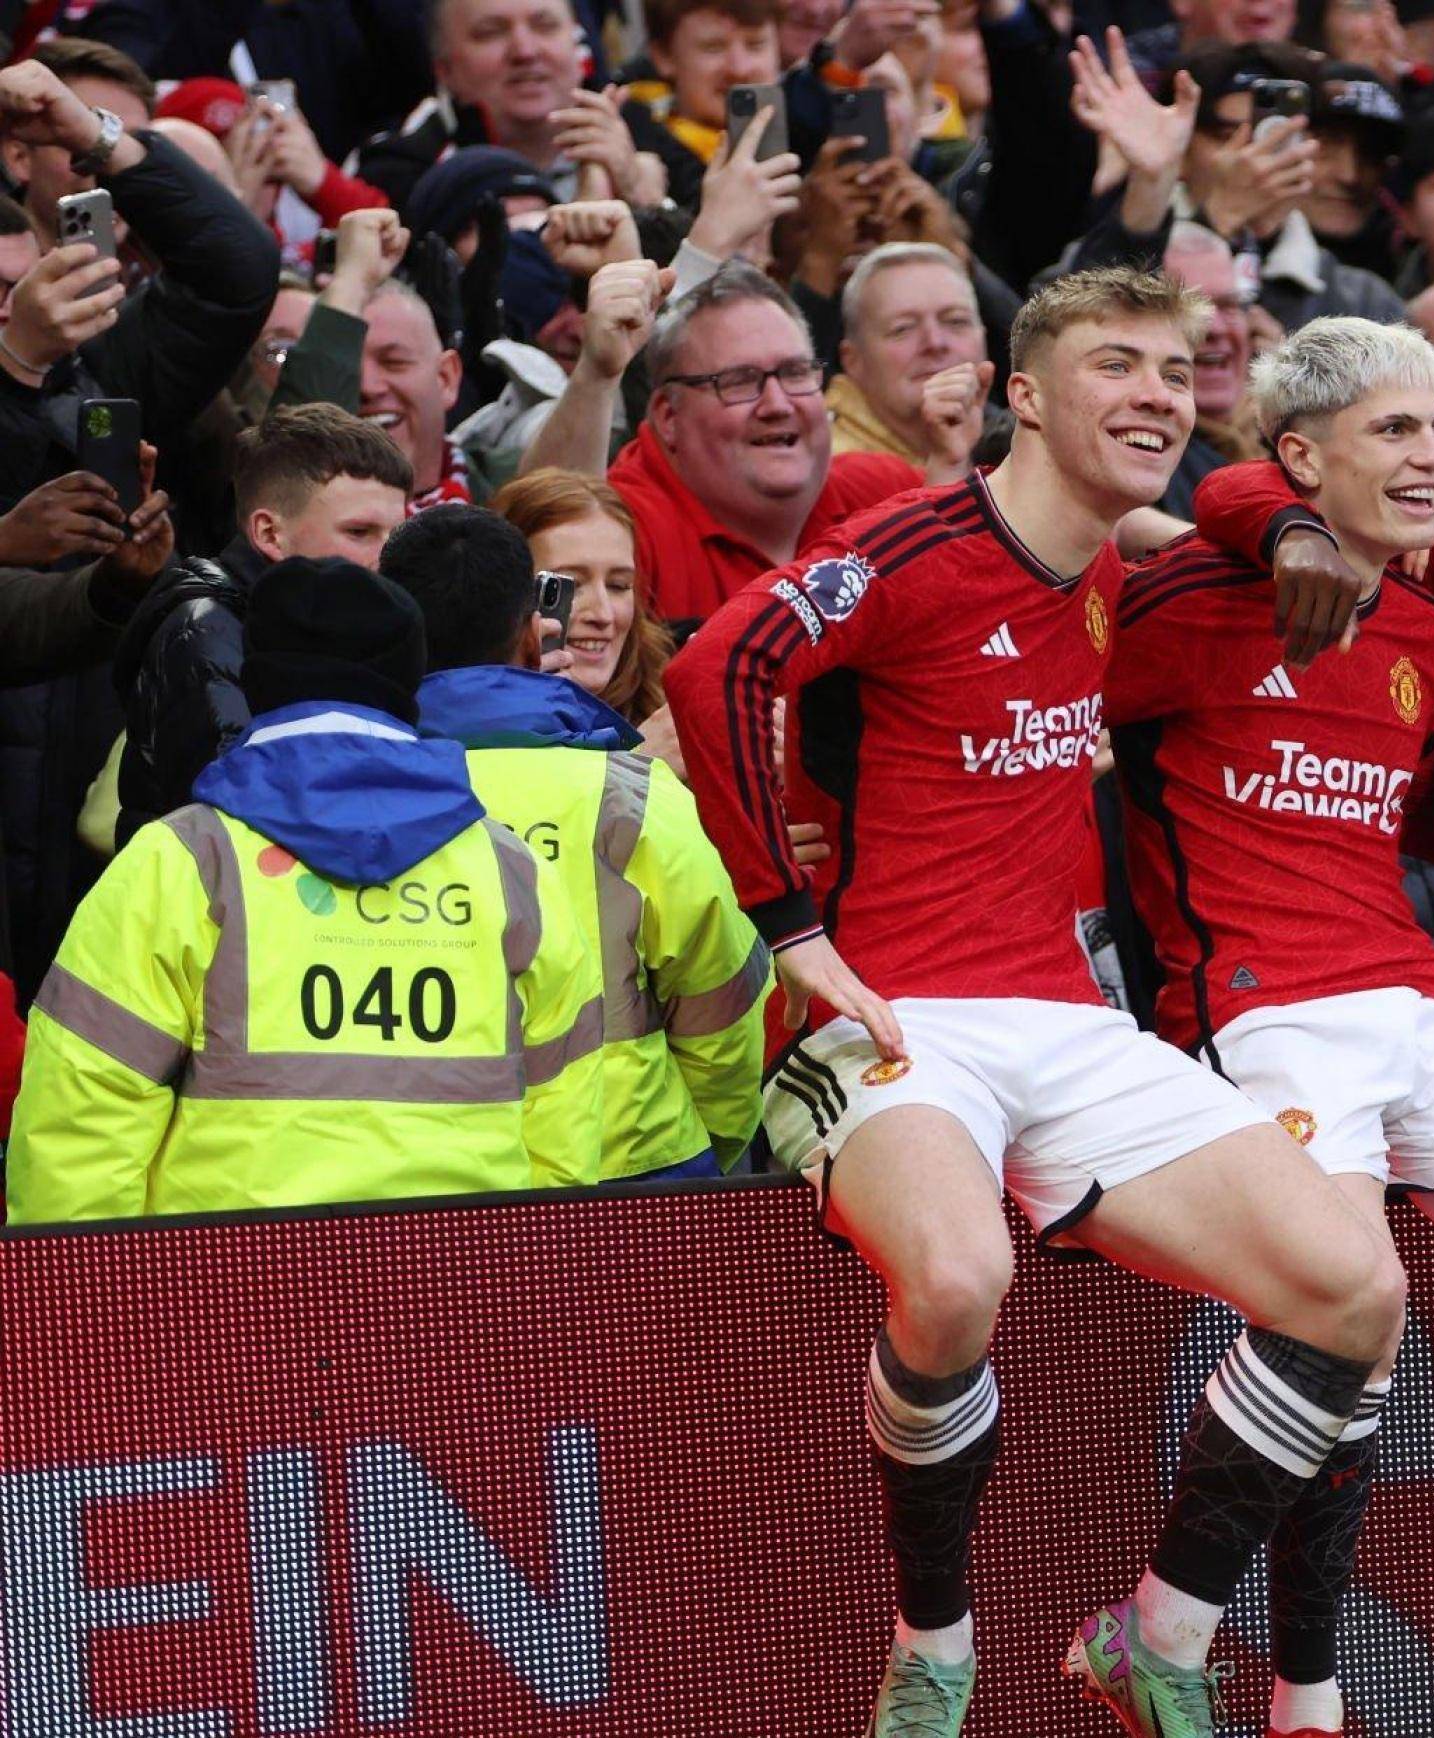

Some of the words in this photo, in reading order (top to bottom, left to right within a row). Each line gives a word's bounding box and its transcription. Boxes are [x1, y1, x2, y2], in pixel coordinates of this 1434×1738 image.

[1006, 696, 1090, 743] Team
[961, 732, 1087, 776] Viewer
[1271, 739, 1386, 798] Team
[1223, 765, 1379, 825] Viewer
[356, 882, 472, 926] CSG
[378, 937, 437, 949] SOLUTIONS
[441, 938, 478, 949] GROUP
[301, 963, 456, 1043] 040
